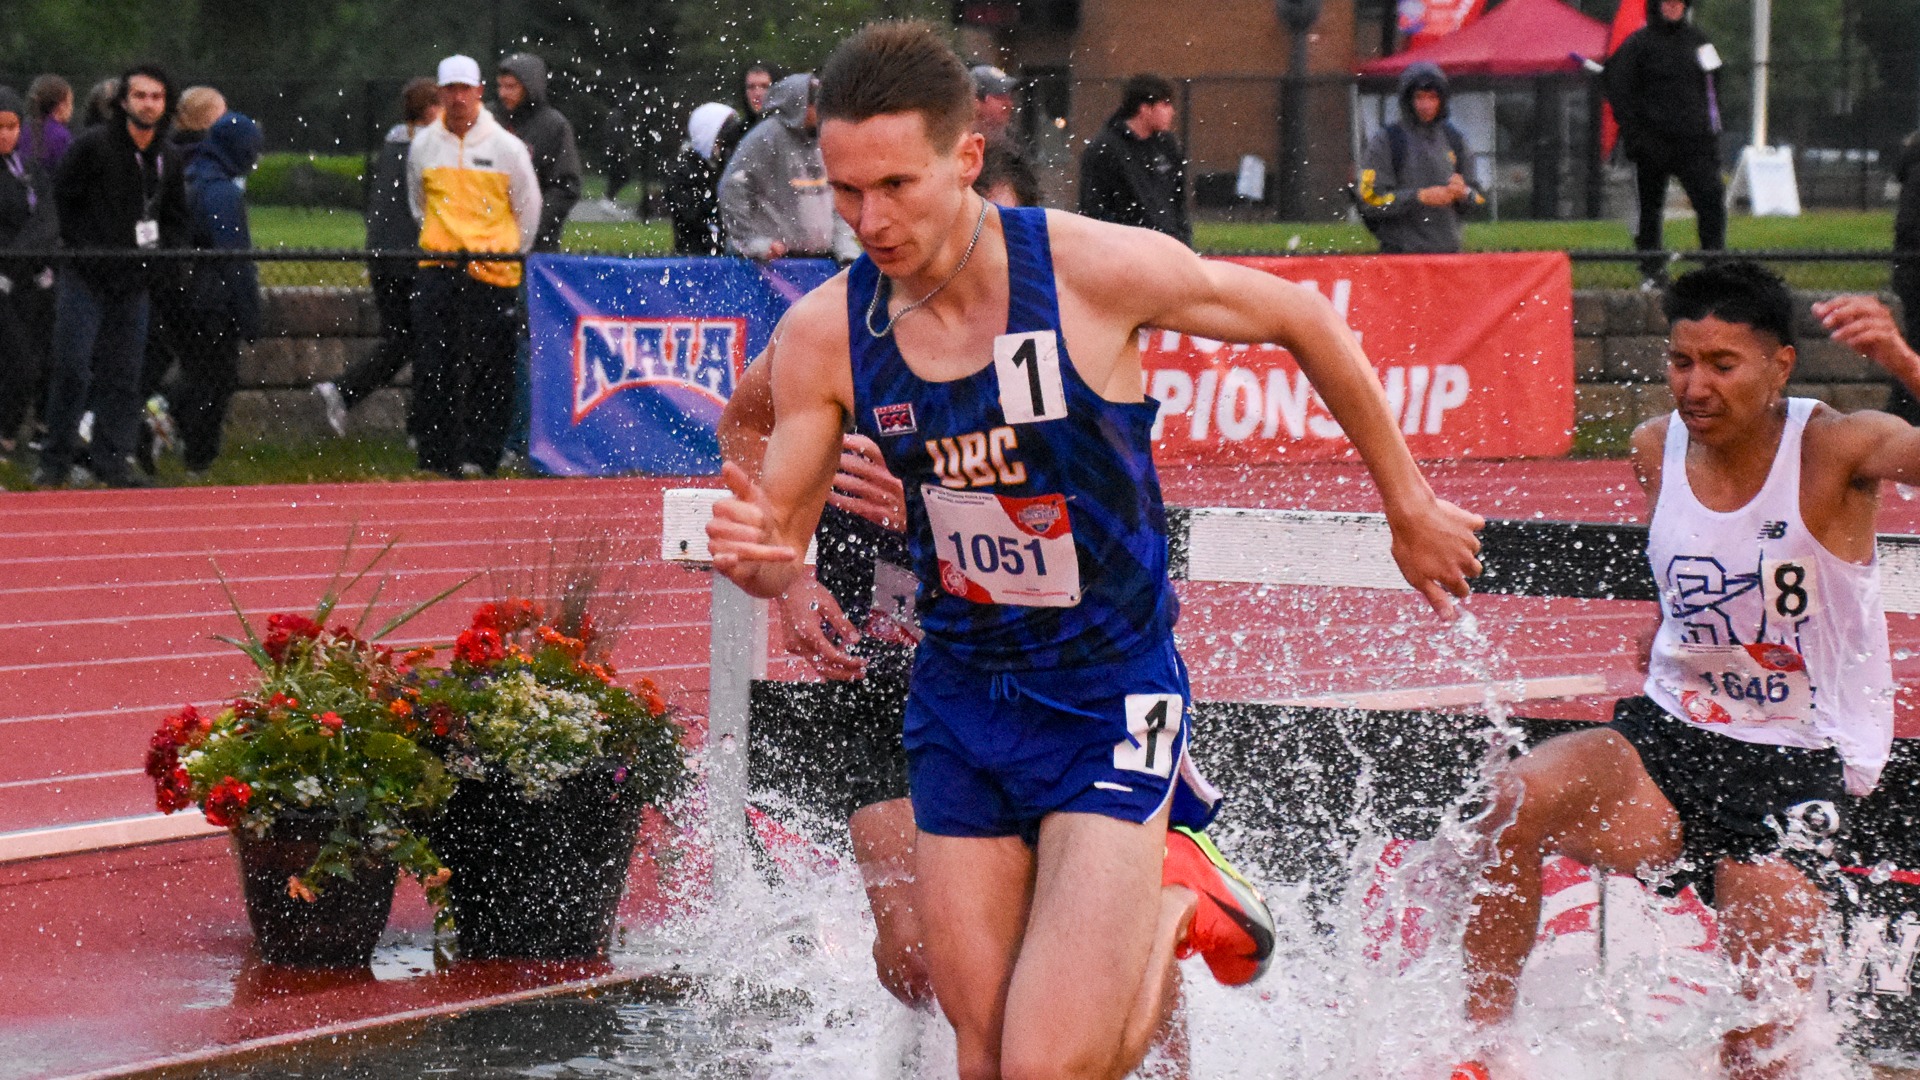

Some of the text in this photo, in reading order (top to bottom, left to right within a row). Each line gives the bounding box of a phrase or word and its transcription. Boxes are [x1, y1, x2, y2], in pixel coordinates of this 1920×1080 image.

[574, 319, 740, 413] NAIA
[1012, 338, 1045, 417] 1
[1142, 365, 1470, 441] PIONHIP
[925, 425, 1027, 489] UBC
[948, 531, 1047, 577] 1051
[1774, 563, 1808, 617] 8
[1699, 671, 1790, 707] 1646
[1144, 700, 1168, 769] 1
